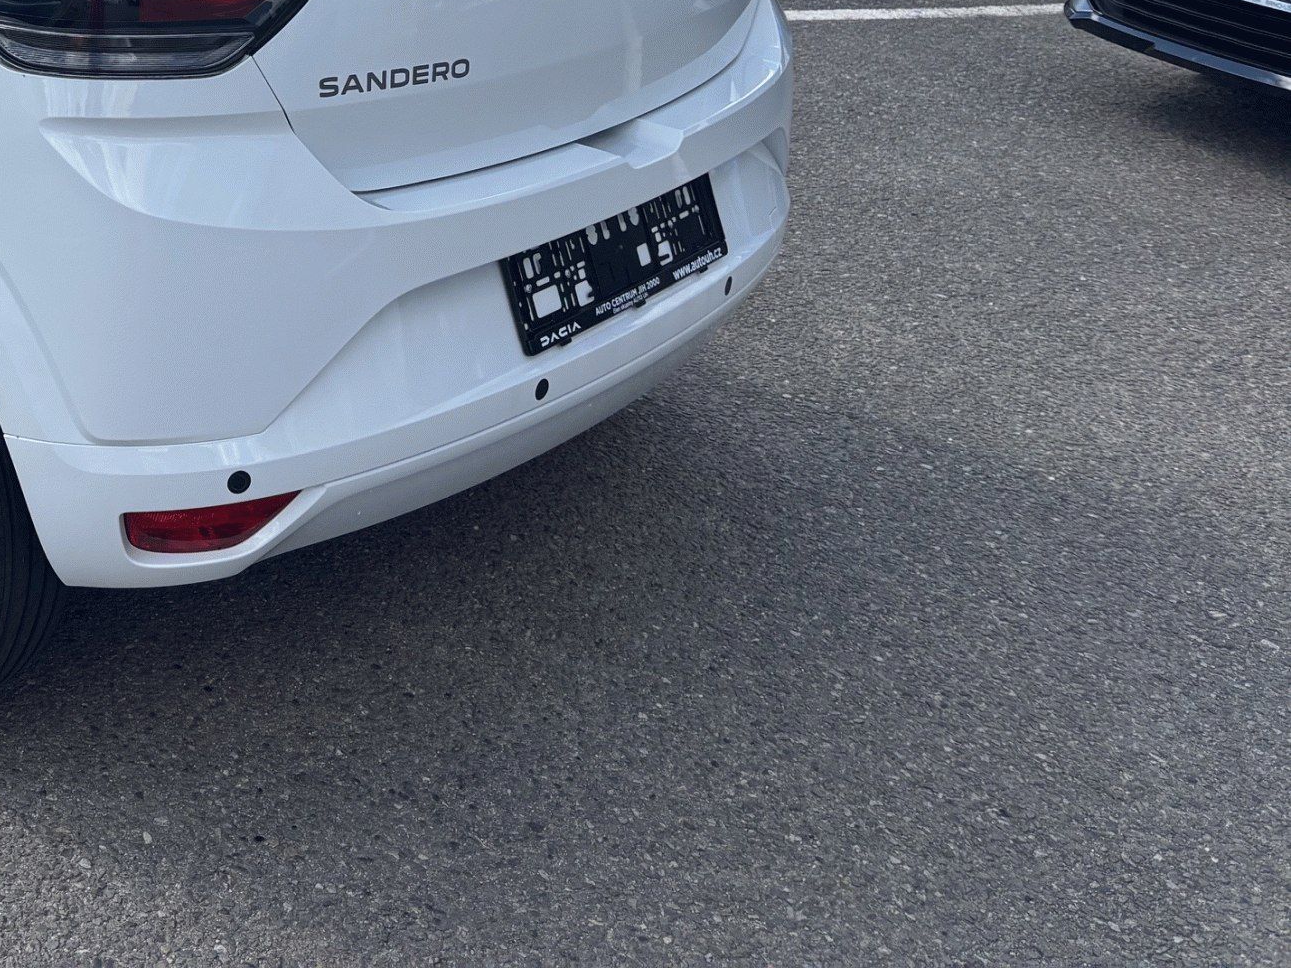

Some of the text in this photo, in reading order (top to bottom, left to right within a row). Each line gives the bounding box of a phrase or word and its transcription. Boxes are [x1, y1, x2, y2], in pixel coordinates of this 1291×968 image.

[318, 57, 471, 98] SANDERO
[672, 247, 723, 280] www.autouh.cz
[595, 301, 612, 316] AUTO
[611, 287, 638, 308] CENTRUM
[646, 276, 661, 290] 2000
[539, 321, 582, 348] DACIA
